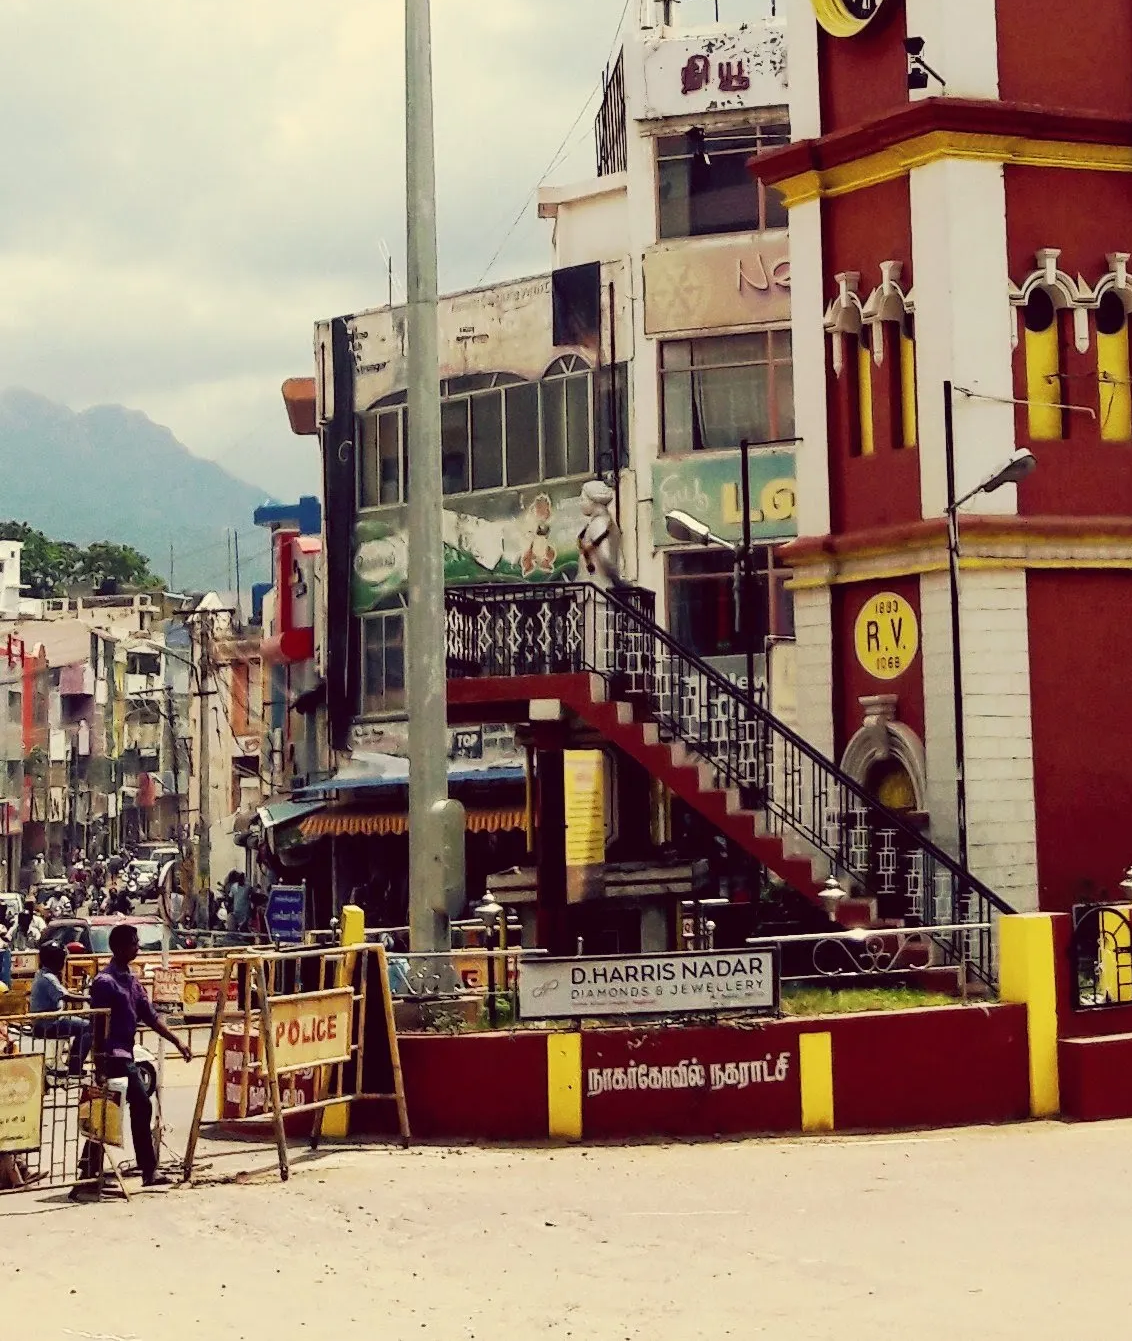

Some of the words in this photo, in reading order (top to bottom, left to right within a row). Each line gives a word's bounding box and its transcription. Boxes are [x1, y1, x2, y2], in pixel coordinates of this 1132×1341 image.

[571, 962, 675, 985] D.HARRIS
[682, 957, 763, 979] NADAR
[571, 985, 649, 1000] DIAMONDS
[671, 979, 764, 996] JEWELLERY
[275, 1014, 337, 1047] POLICE
[587, 1057, 705, 1097] நாகர்கோவில்
[710, 1052, 791, 1090] நகராட்சி
